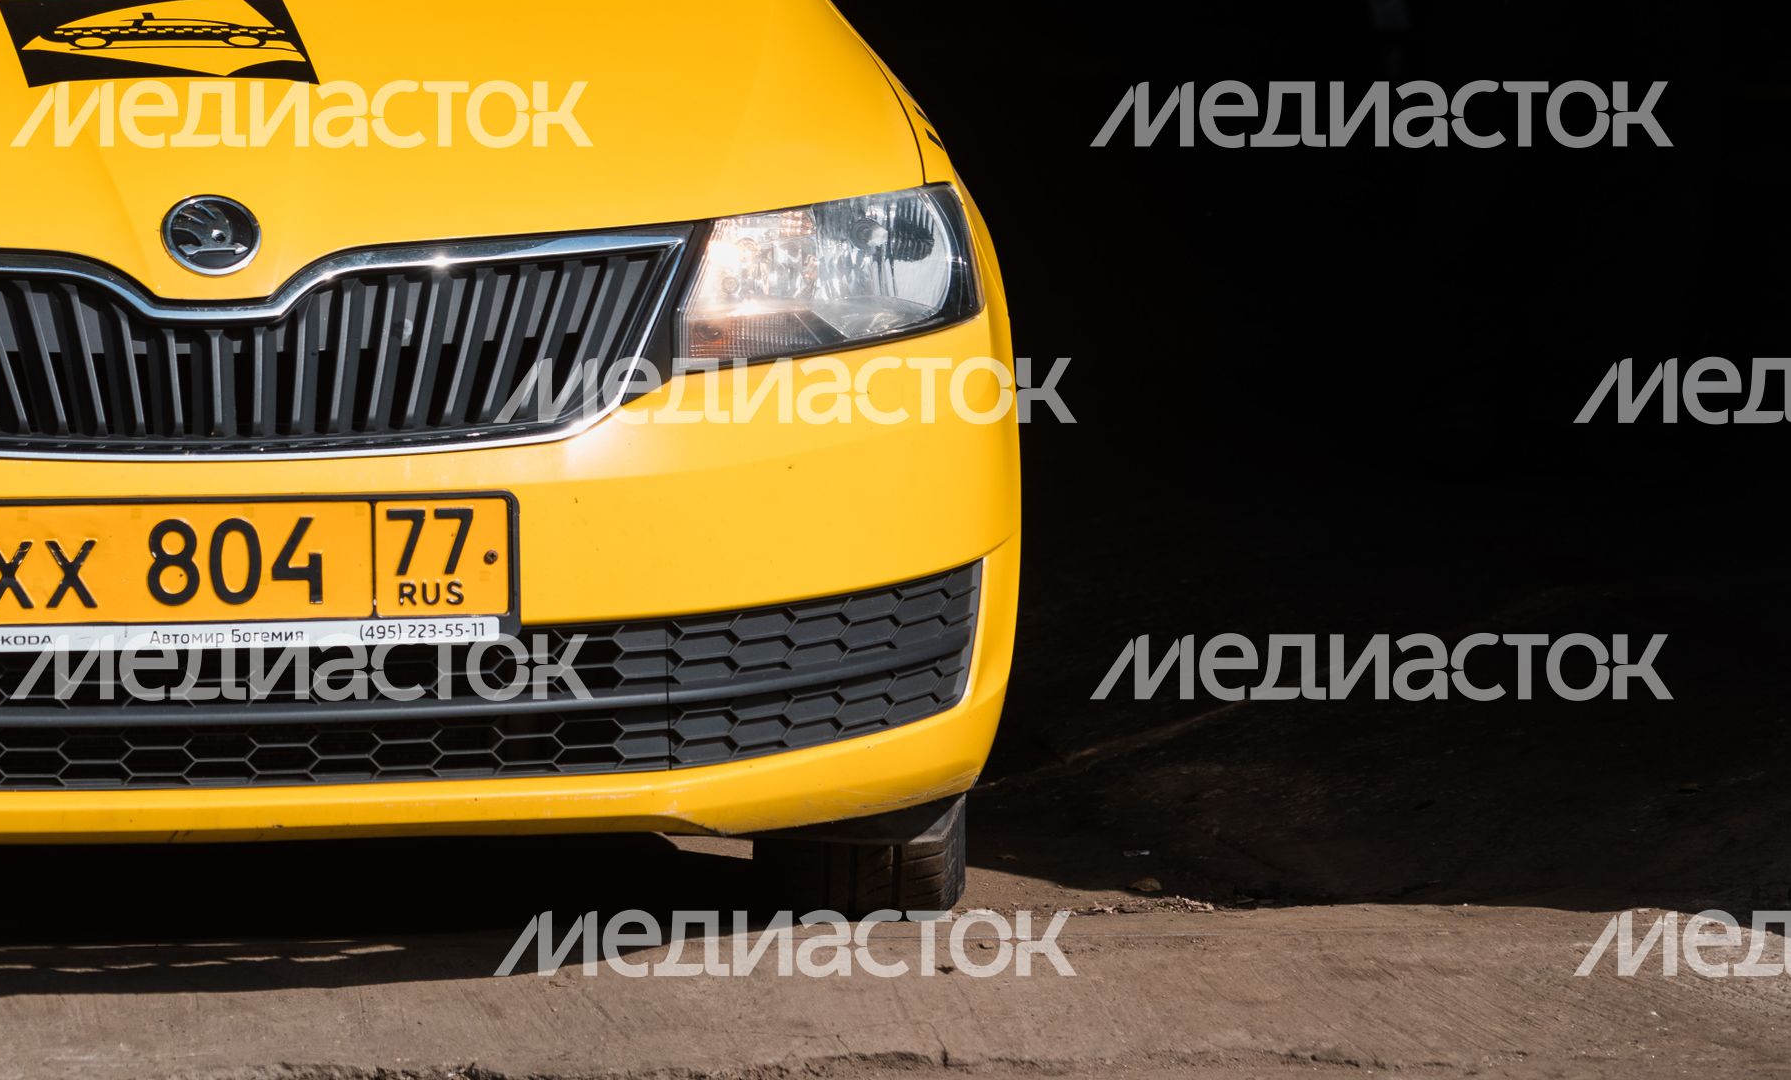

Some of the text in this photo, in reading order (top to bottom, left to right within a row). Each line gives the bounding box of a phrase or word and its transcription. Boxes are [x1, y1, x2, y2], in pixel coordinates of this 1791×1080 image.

[147, 518, 323, 607] 804
[386, 508, 474, 577] 77
[398, 581, 465, 606] RUS
[149, 628, 305, 648] Автомир Богемия
[359, 622, 486, 642] (495) 223-55-11
